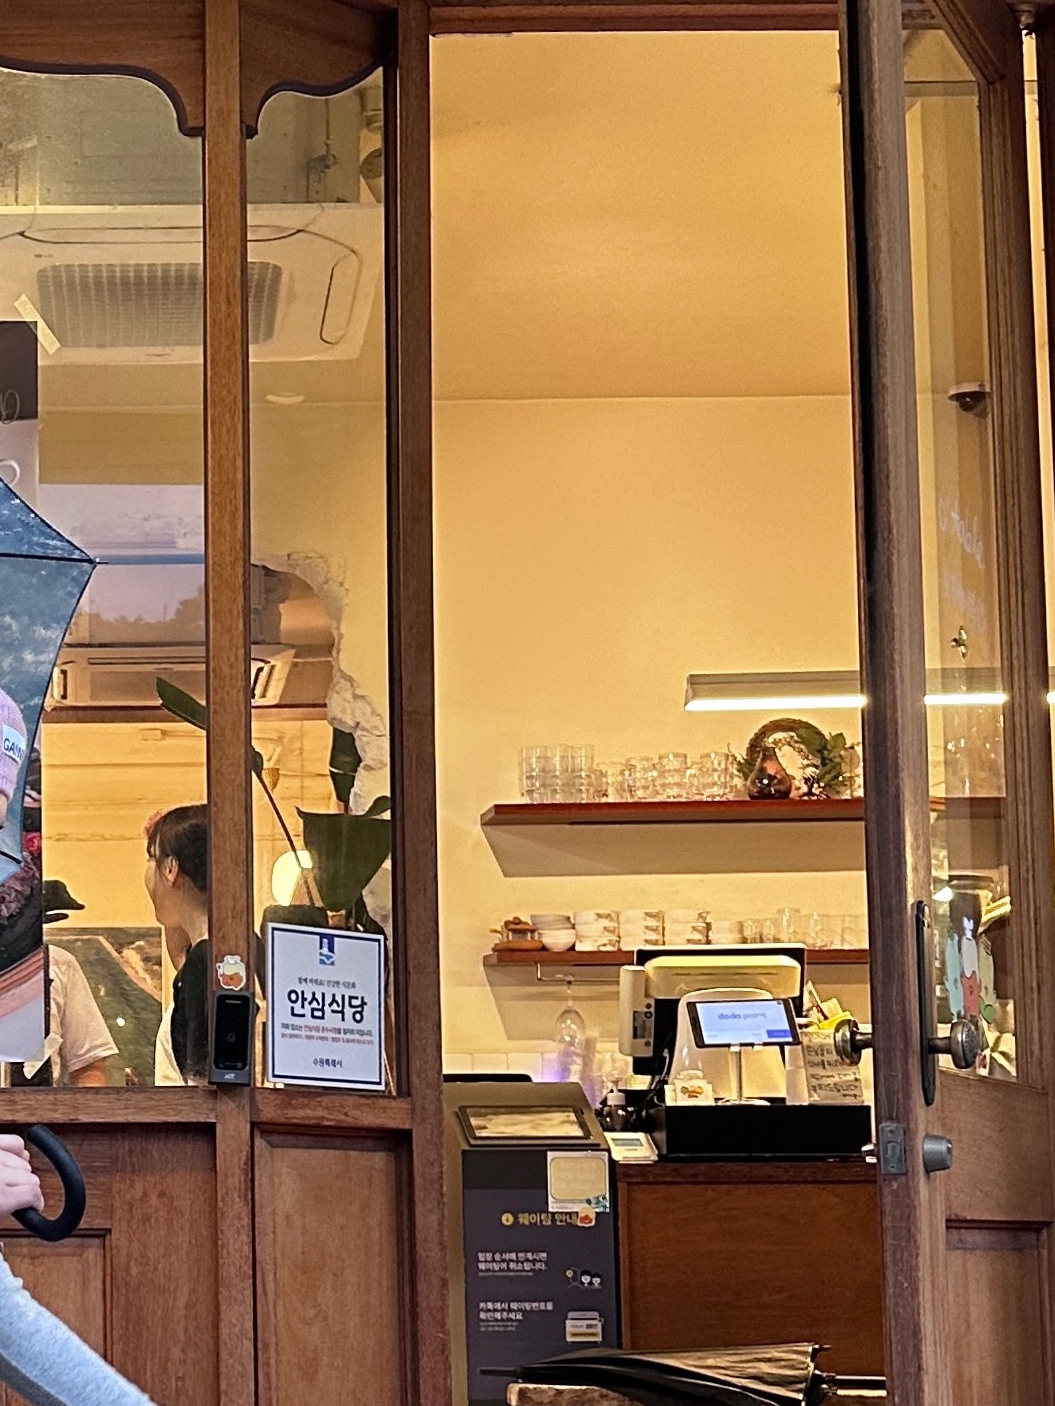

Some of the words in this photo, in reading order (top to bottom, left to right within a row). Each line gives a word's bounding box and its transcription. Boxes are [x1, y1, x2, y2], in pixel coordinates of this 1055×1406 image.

[287, 988, 368, 1024] 안심식당
[313, 1057, 343, 1068] 수원특례시
[518, 1212, 552, 1226] 웨이팅
[554, 1212, 579, 1226] 안내
